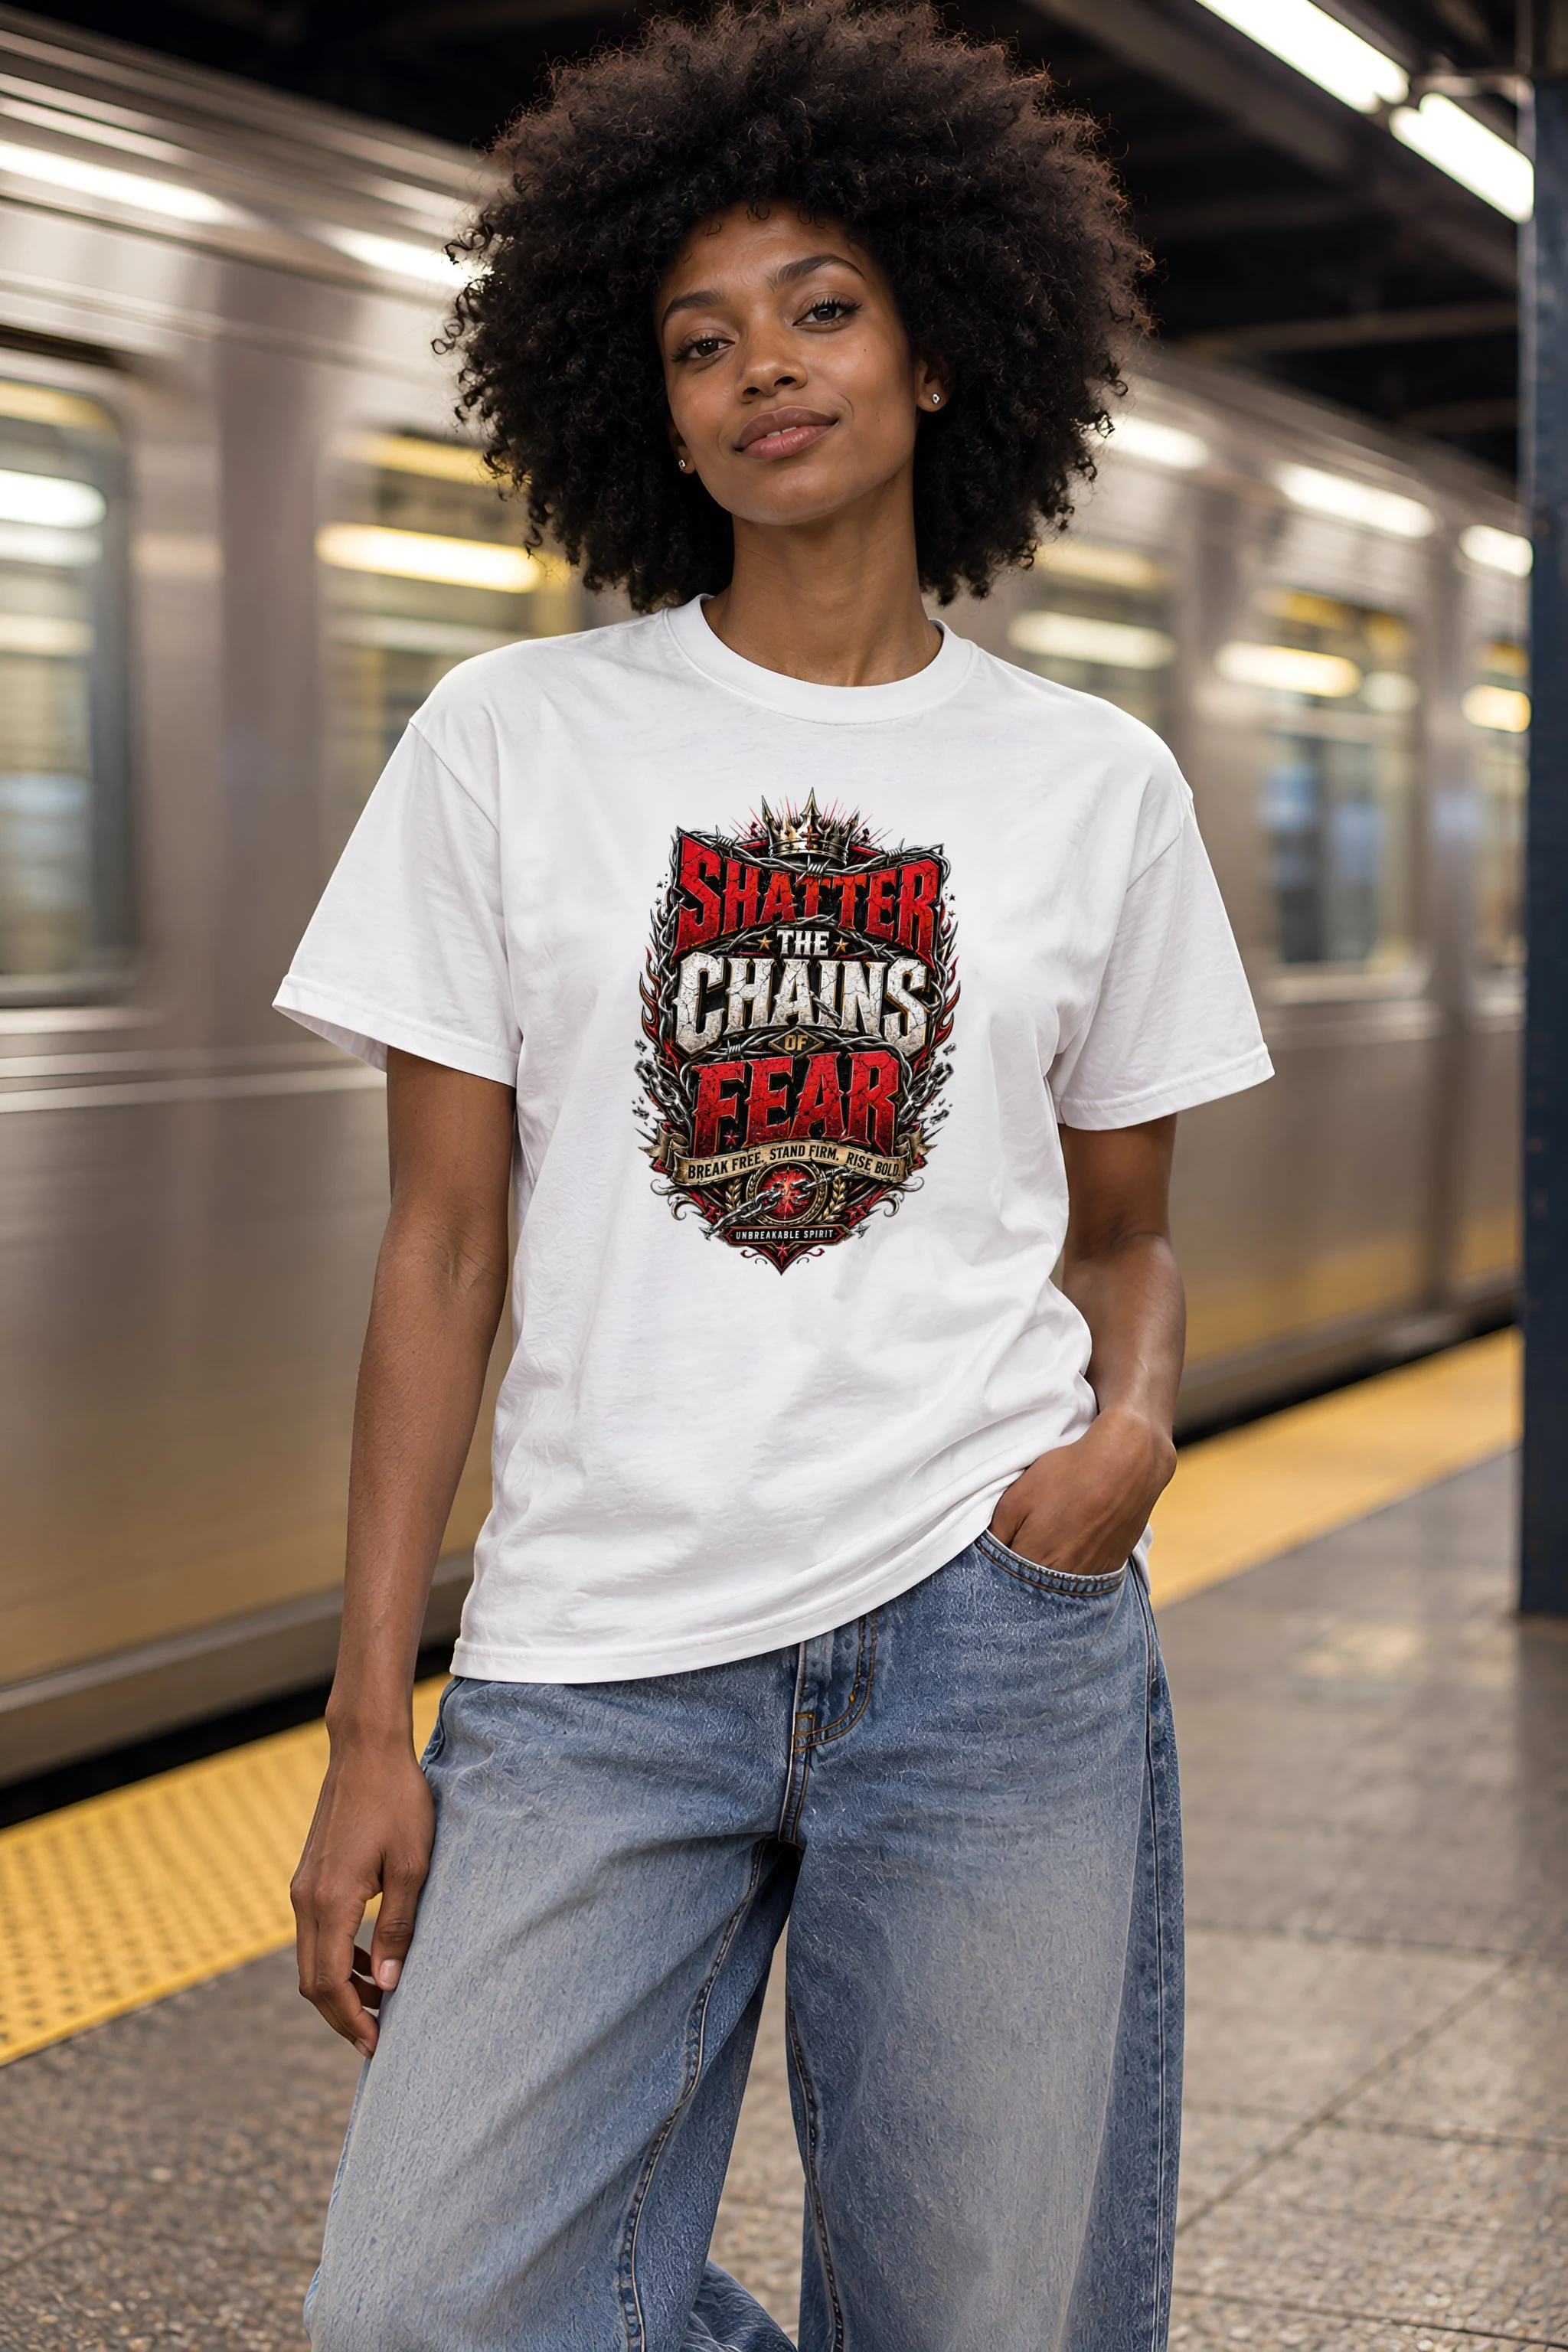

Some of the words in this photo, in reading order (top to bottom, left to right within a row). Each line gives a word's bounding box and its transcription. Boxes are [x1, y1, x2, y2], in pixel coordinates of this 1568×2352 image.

[673, 835, 940, 968] SHATTER
[776, 929, 830, 957] THE
[671, 952, 930, 1055] CHAINS
[783, 1034, 809, 1052] OF
[692, 1050, 900, 1158] FEAR
[688, 1160, 728, 1179] BREAK
[732, 1152, 765, 1171] FREE.
[769, 1145, 805, 1161] STAND
[808, 1145, 839, 1161] FIRM.
[845, 1152, 873, 1171] RISE
[874, 1161, 901, 1177] BOLD.
[736, 1230, 799, 1240] UNBREAKABLE
[803, 1230, 834, 1239] SPIRIT
